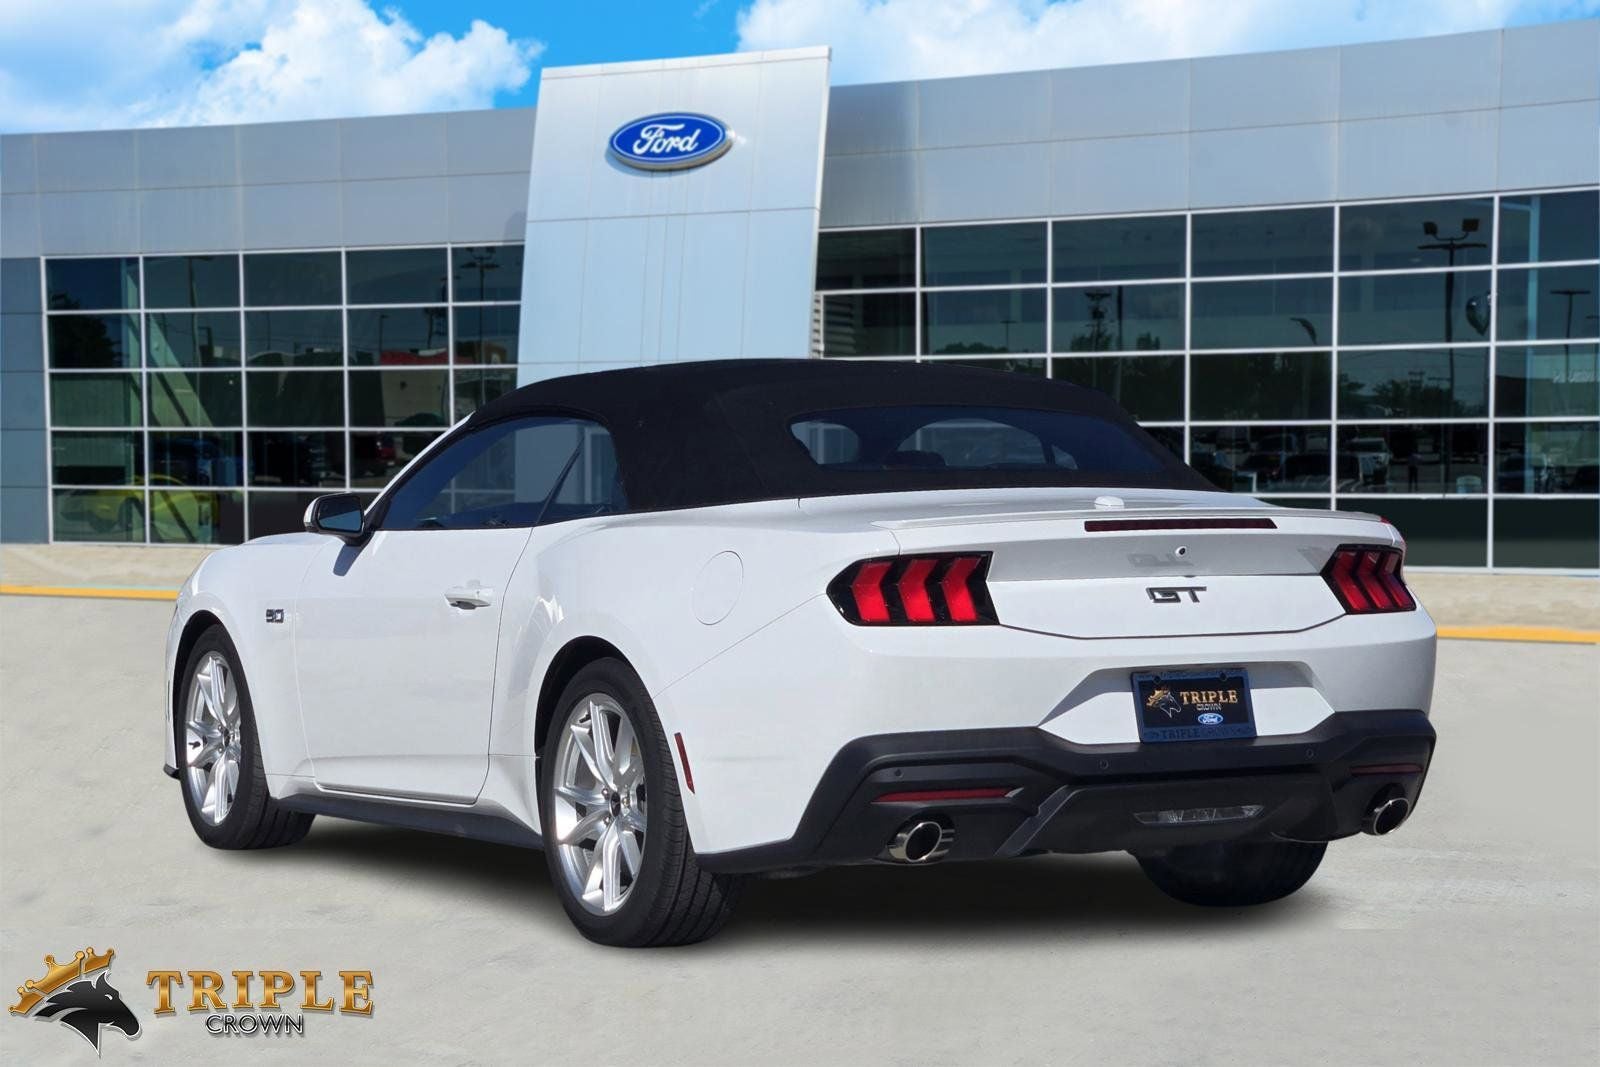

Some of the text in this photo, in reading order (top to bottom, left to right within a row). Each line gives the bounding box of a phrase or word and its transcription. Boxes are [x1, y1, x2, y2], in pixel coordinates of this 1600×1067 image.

[633, 123, 701, 155] Ford
[1146, 586, 1207, 603] GT
[1181, 690, 1238, 705] TRIPLE
